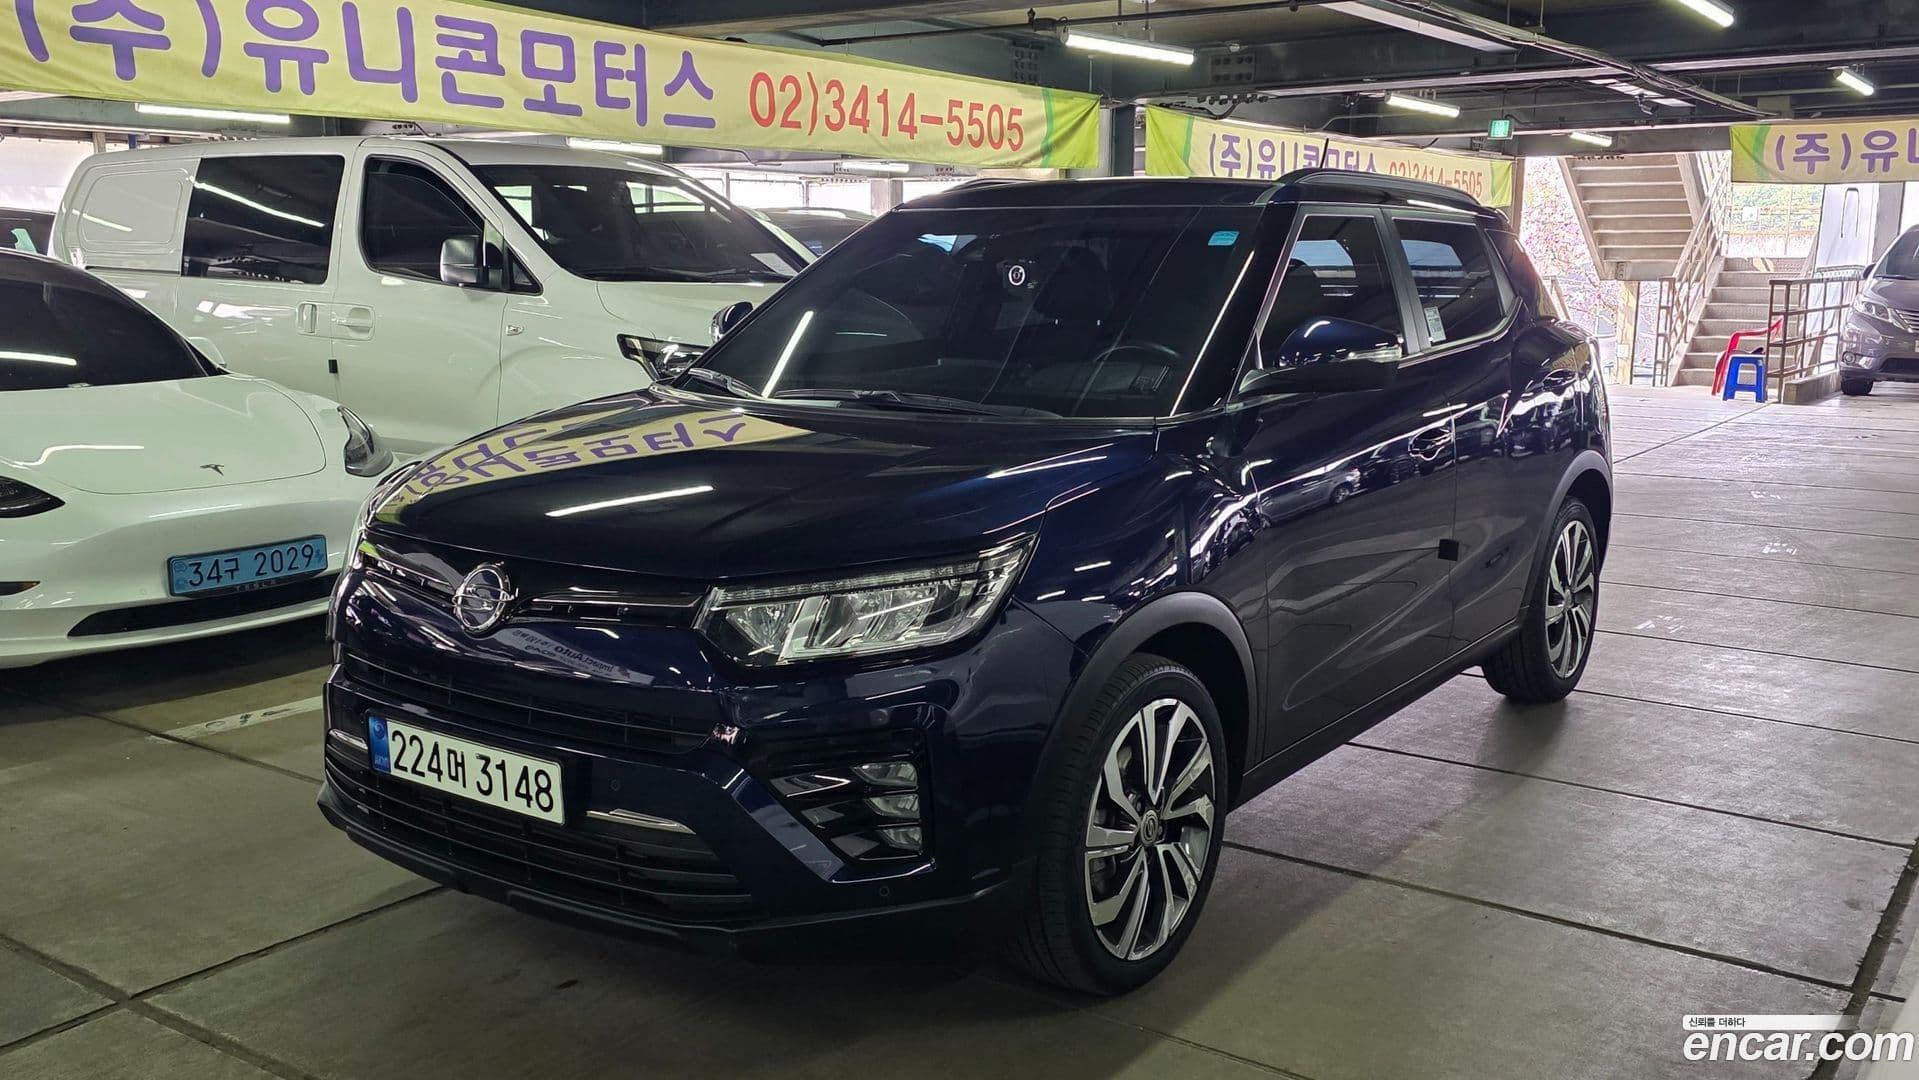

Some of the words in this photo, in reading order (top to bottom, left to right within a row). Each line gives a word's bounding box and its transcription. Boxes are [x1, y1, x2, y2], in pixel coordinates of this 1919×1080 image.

[747, 70, 1026, 153] 02)3414-5505
[188, 557, 241, 587] 34구
[254, 544, 315, 577] 2029
[391, 730, 467, 788] 224머
[475, 752, 555, 813] 3148
